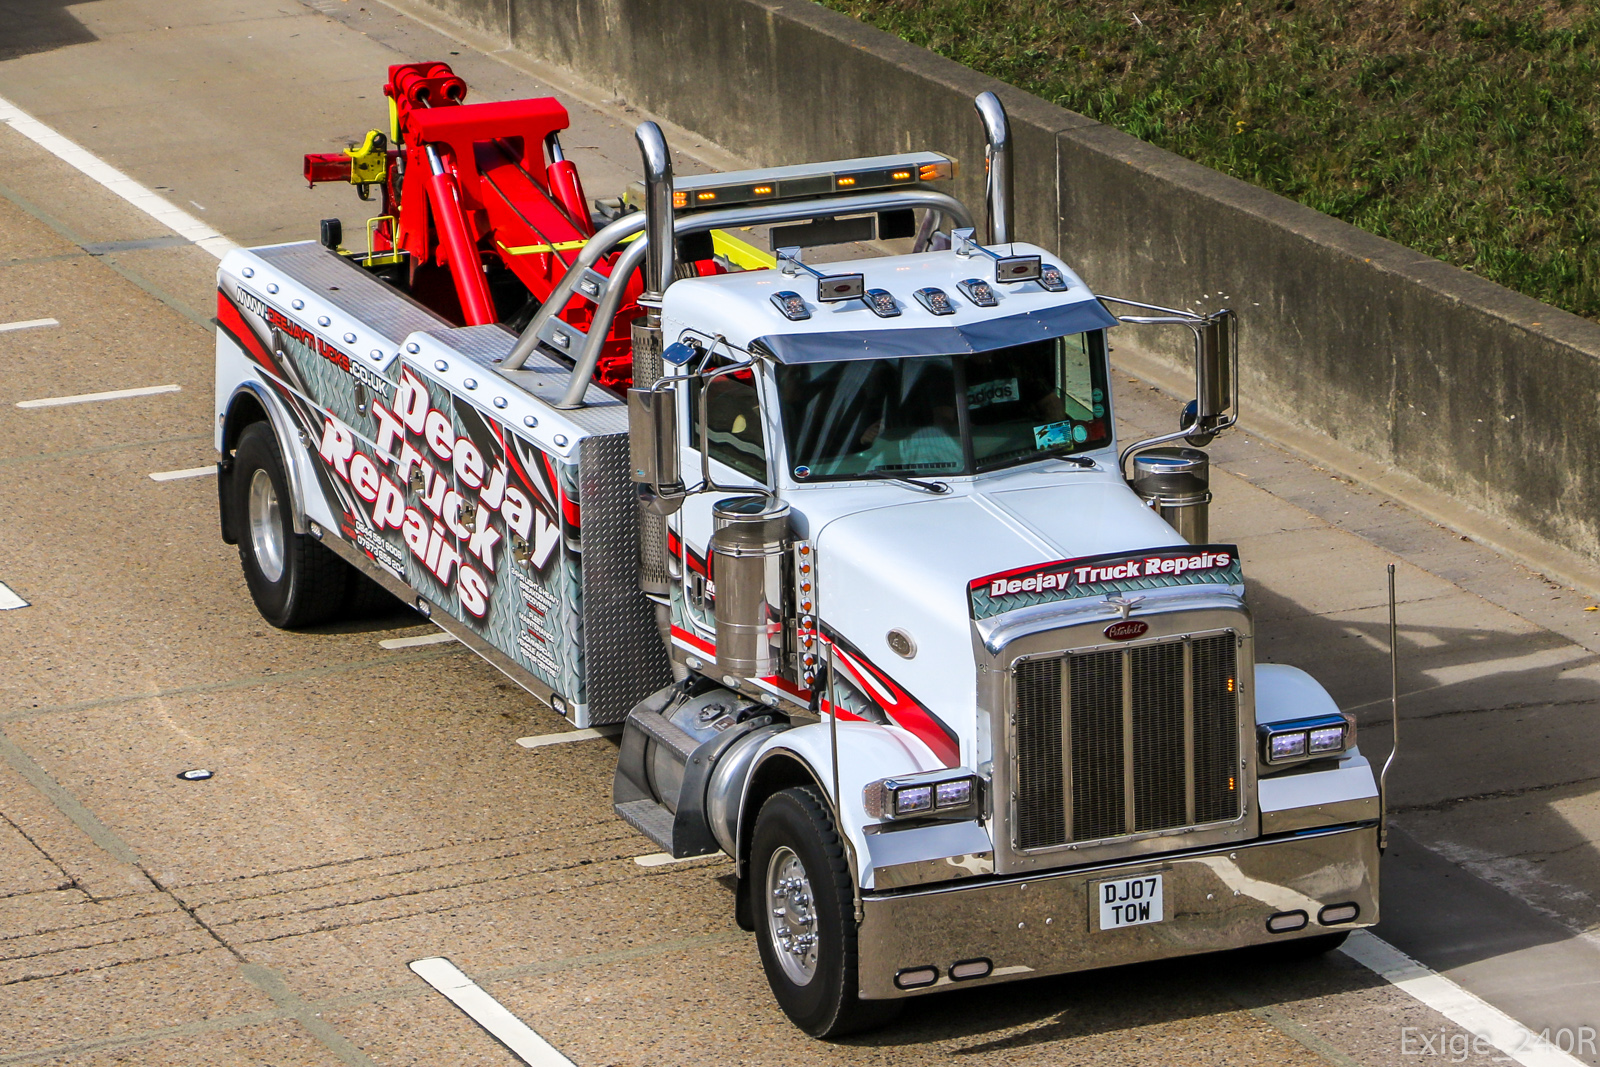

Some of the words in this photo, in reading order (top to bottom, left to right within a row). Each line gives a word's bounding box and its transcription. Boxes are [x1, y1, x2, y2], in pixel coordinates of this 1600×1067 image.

[372, 399, 503, 574] Truck
[393, 365, 561, 570] Deejay
[319, 408, 490, 620] Repairs
[990, 570, 1069, 598] Deejay
[1074, 561, 1141, 585] Truck
[1144, 550, 1230, 576] Repairs
[1109, 623, 1145, 638] Peterbilt
[1104, 878, 1157, 904] DJ07
[1111, 901, 1150, 925] TOW
